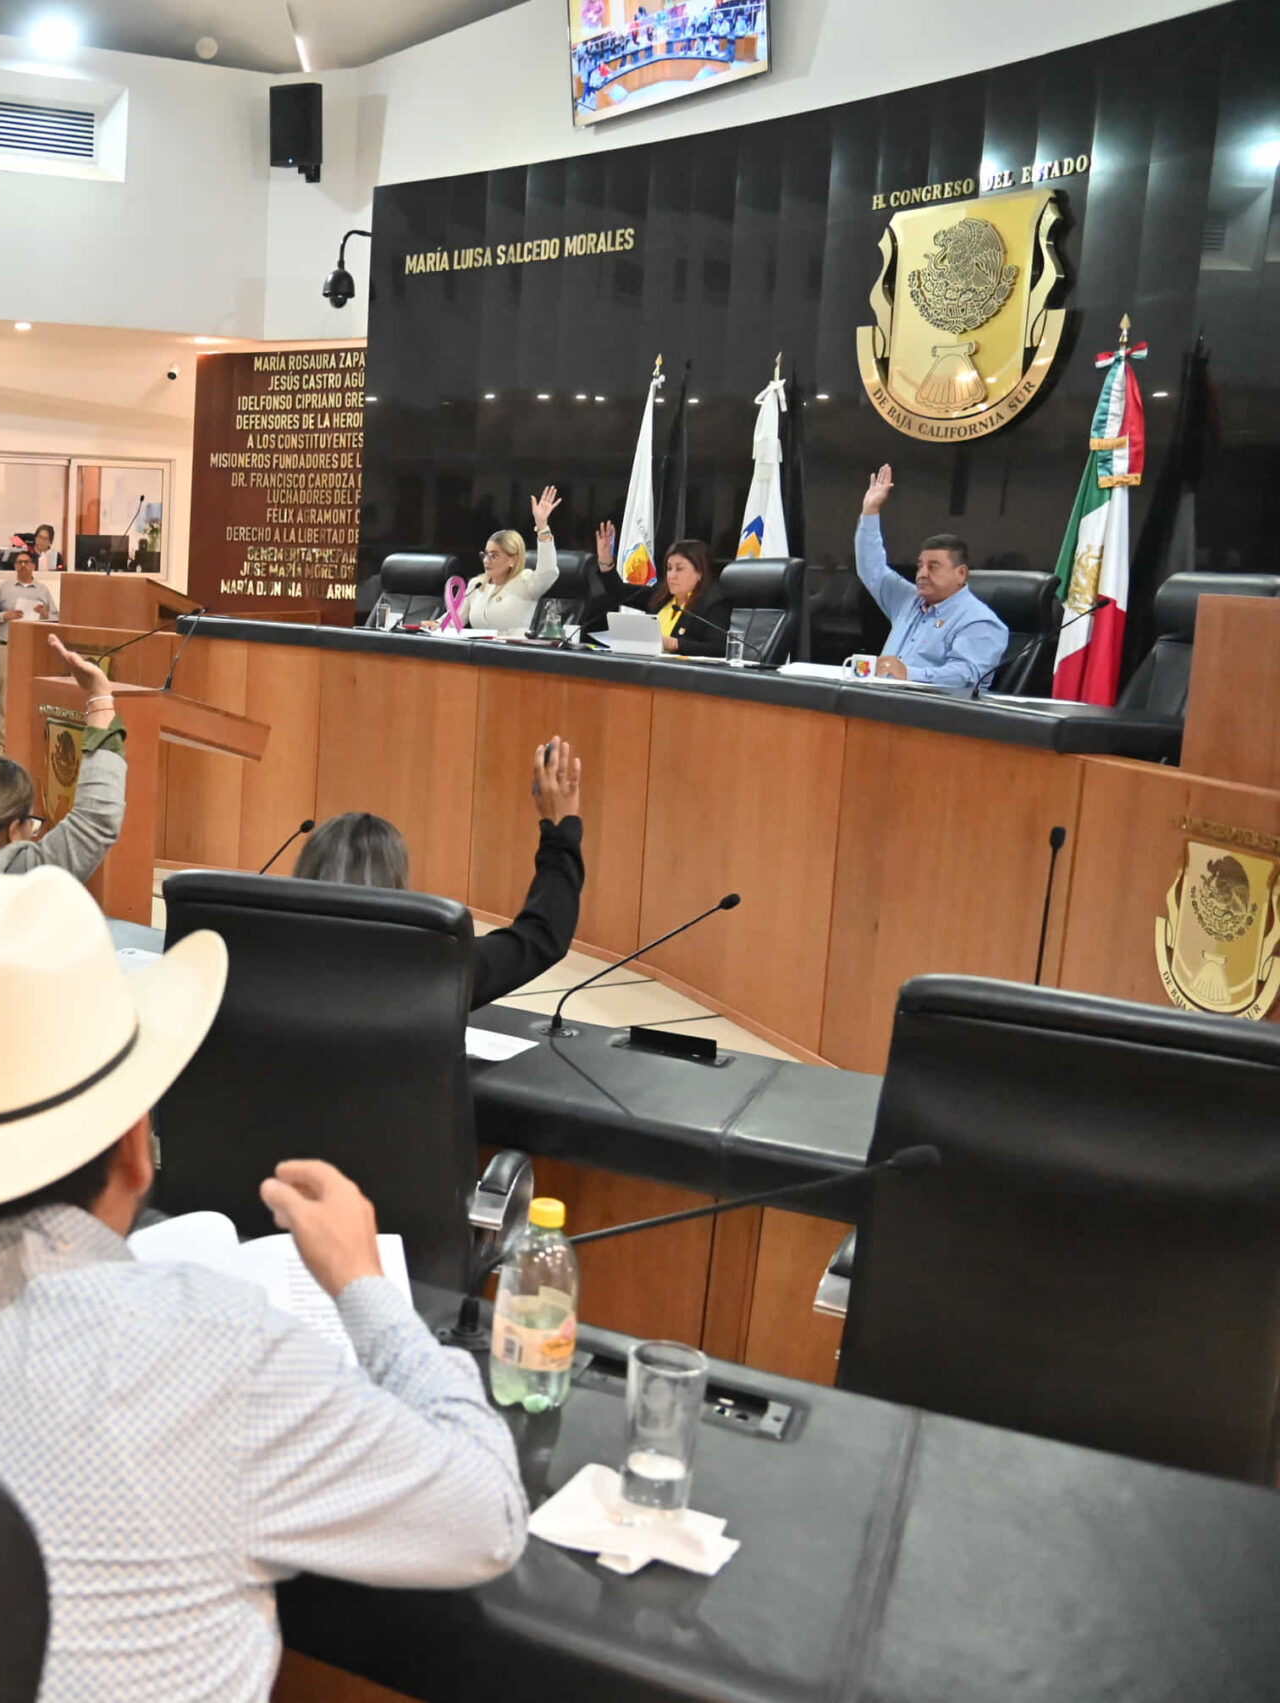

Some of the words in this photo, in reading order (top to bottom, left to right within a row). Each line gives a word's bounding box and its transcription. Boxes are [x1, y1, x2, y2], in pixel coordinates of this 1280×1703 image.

[872, 194, 886, 210] H.
[890, 178, 975, 207] CONGRESO
[981, 170, 1013, 192] DEL
[1021, 155, 1089, 184] ESTADO
[405, 247, 449, 275] MARÍA
[453, 247, 492, 270] LUISA
[496, 238, 560, 265] SALCEDO
[564, 228, 635, 258] MORALES
[254, 352, 286, 371] MARÍA
[289, 354, 336, 370] ROSAURA
[268, 371, 300, 391] JESÚS
[302, 373, 341, 390] CASTRO
[238, 395, 292, 411] IDELFONSO
[295, 393, 342, 409] CIPRIANO
[873, 388, 888, 409] DE
[886, 405, 912, 430] BAJA
[918, 411, 1005, 439] CALIFORNIA
[1008, 380, 1037, 412] SUR
[236, 413, 299, 430] DEFENSORES
[302, 413, 314, 429] DE
[317, 413, 330, 428] LA
[247, 433, 254, 449] A
[256, 433, 276, 449] LOS
[277, 432, 364, 449] CONSTITUYENTES
[210, 452, 270, 468] MISIONEROS
[272, 453, 338, 469] FUNDADORES
[340, 453, 353, 468] DE
[231, 472, 247, 487] DR.
[250, 472, 305, 488] FRANCISCO
[308, 472, 355, 488] CARDOZA
[267, 488, 332, 504] LUCHADORES
[334, 489, 353, 504] DEL
[266, 505, 294, 523] FÉLIX
[297, 508, 354, 524] AGRAMONT
[226, 526, 271, 542] DERECHO
[274, 527, 280, 542] A
[283, 527, 297, 542] LA
[298, 527, 345, 544] LIBERTAD
